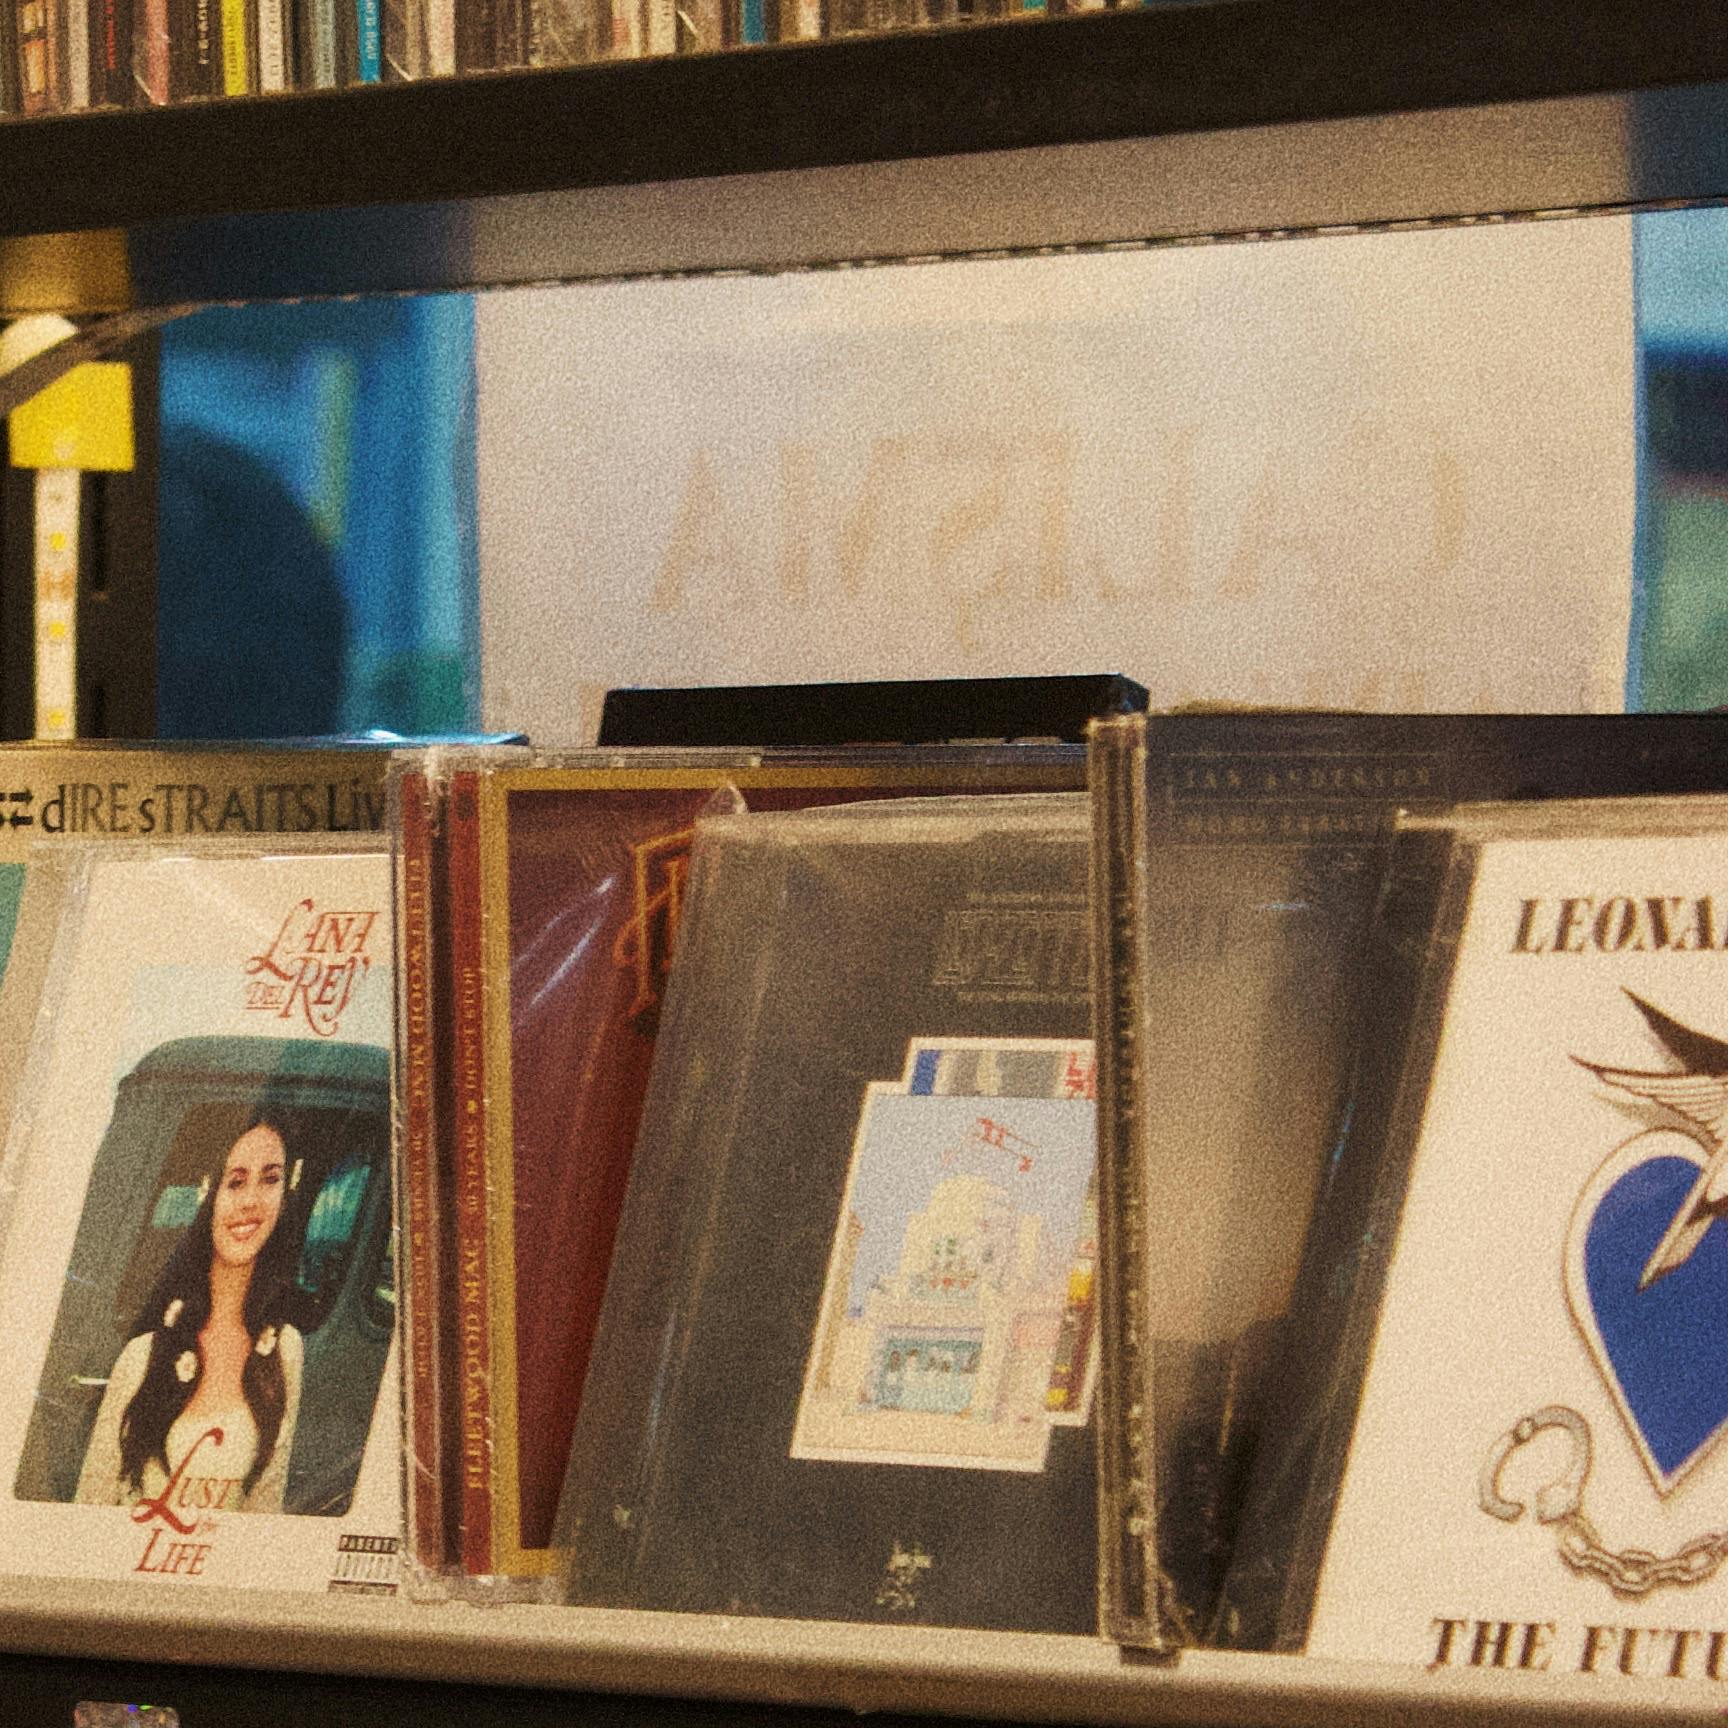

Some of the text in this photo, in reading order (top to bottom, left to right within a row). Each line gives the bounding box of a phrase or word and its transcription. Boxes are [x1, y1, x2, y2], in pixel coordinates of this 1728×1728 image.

[324, 780, 386, 836] Liv
[245, 897, 381, 981] LANA
[1510, 895, 1728, 955] LEONA
[278, 953, 372, 1038] REY
[463, 1237, 483, 1489] FLEETWOOD MAC
[130, 1427, 240, 1535] LUST
[133, 1528, 212, 1578] LIFE
[1426, 1617, 1557, 1676] THE
